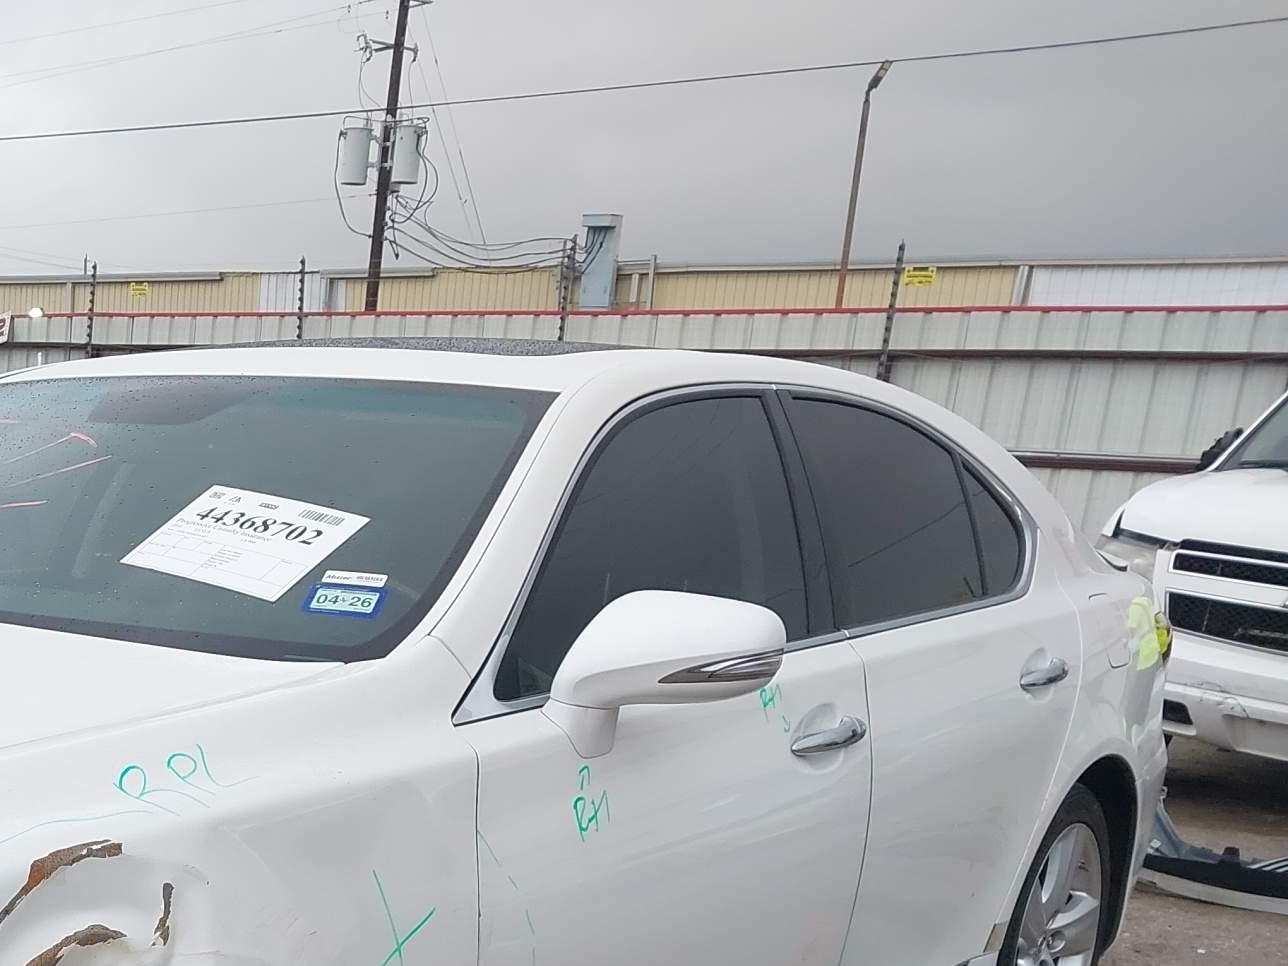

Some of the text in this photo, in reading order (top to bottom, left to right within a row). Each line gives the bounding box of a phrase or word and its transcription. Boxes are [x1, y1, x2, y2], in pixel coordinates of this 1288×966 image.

[196, 506, 323, 546] 44368702
[316, 593, 340, 605] 04
[349, 596, 374, 608] 26
